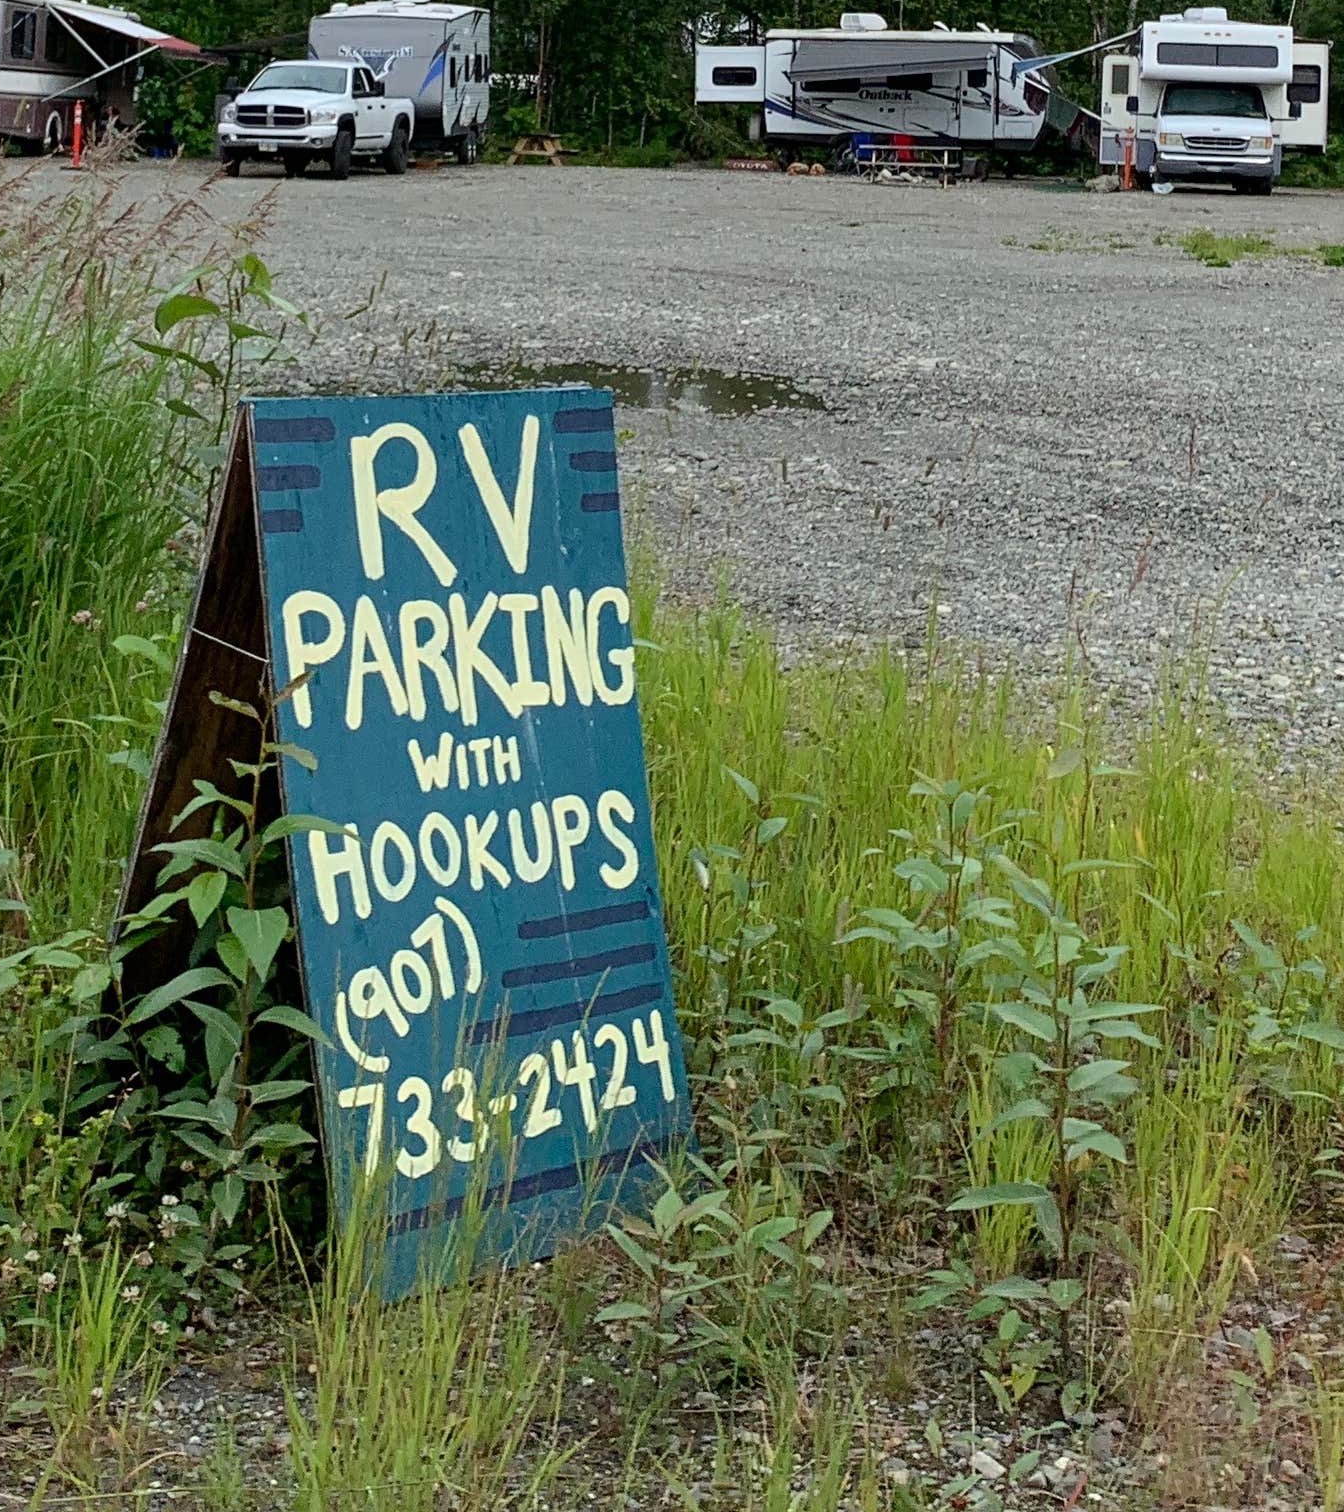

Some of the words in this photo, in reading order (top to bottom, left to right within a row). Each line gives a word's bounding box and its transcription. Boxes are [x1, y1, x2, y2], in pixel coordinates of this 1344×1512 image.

[858, 89, 912, 100] Outback
[350, 414, 540, 587] RV
[281, 585, 636, 730] PARKING
[407, 732, 521, 793] WITH
[308, 790, 639, 925] HOOKUPS
[334, 896, 482, 1074] (907)
[337, 1008, 676, 1180] 733-2424
